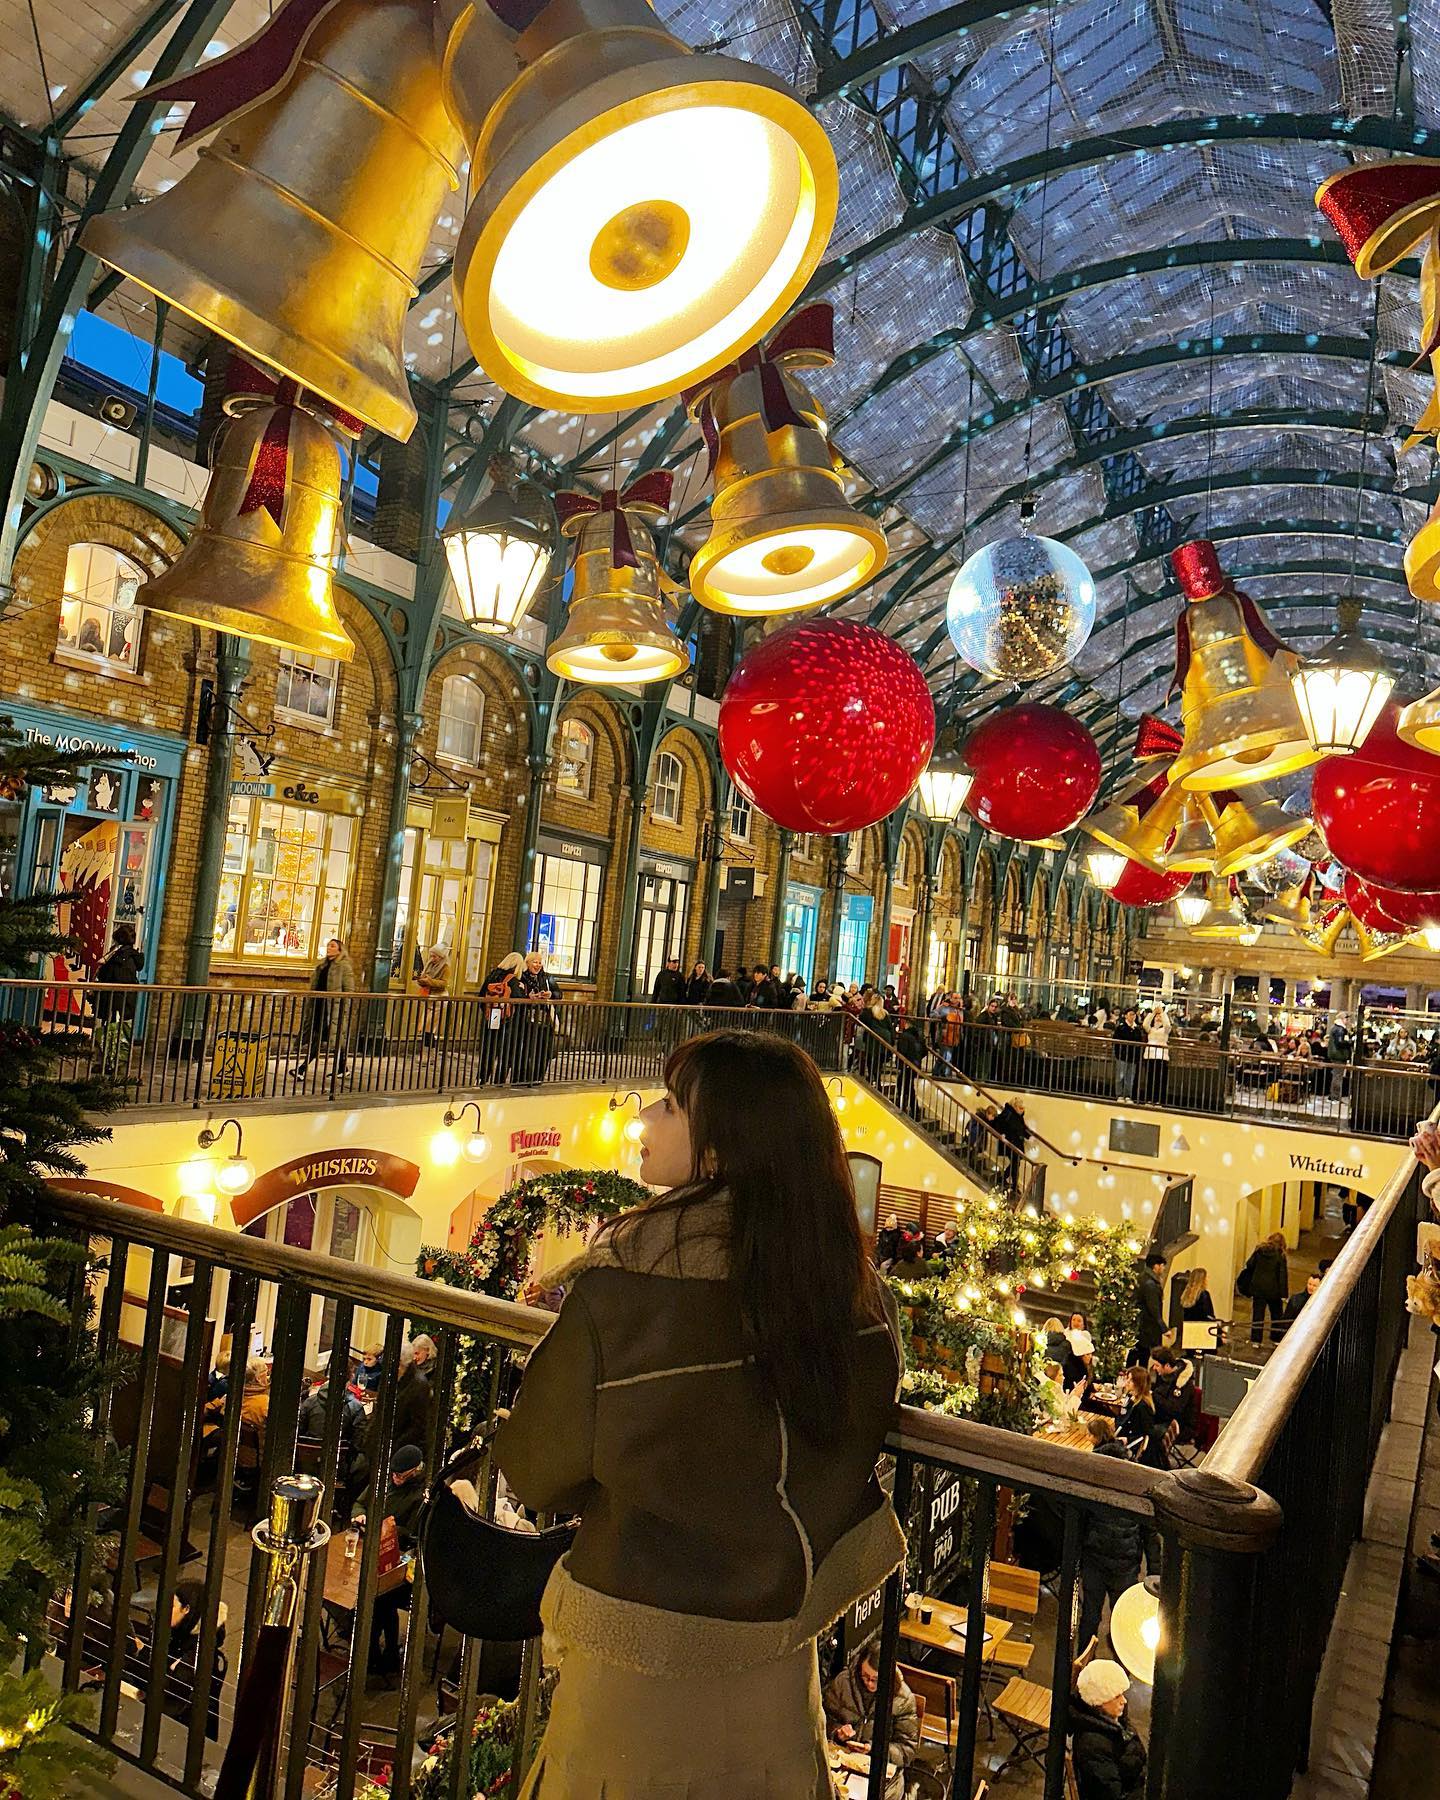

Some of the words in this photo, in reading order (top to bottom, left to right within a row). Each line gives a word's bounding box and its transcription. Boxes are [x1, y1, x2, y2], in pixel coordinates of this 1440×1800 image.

[26, 728, 51, 745] The
[234, 782, 267, 795] MOOMIN
[283, 783, 319, 804] e&e
[289, 1158, 378, 1186] WHISKIES
[1289, 1154, 1363, 1178] Whittard
[929, 1480, 960, 1533] PUB
[934, 1526, 953, 1548] SINCE
[854, 1589, 881, 1629] here
